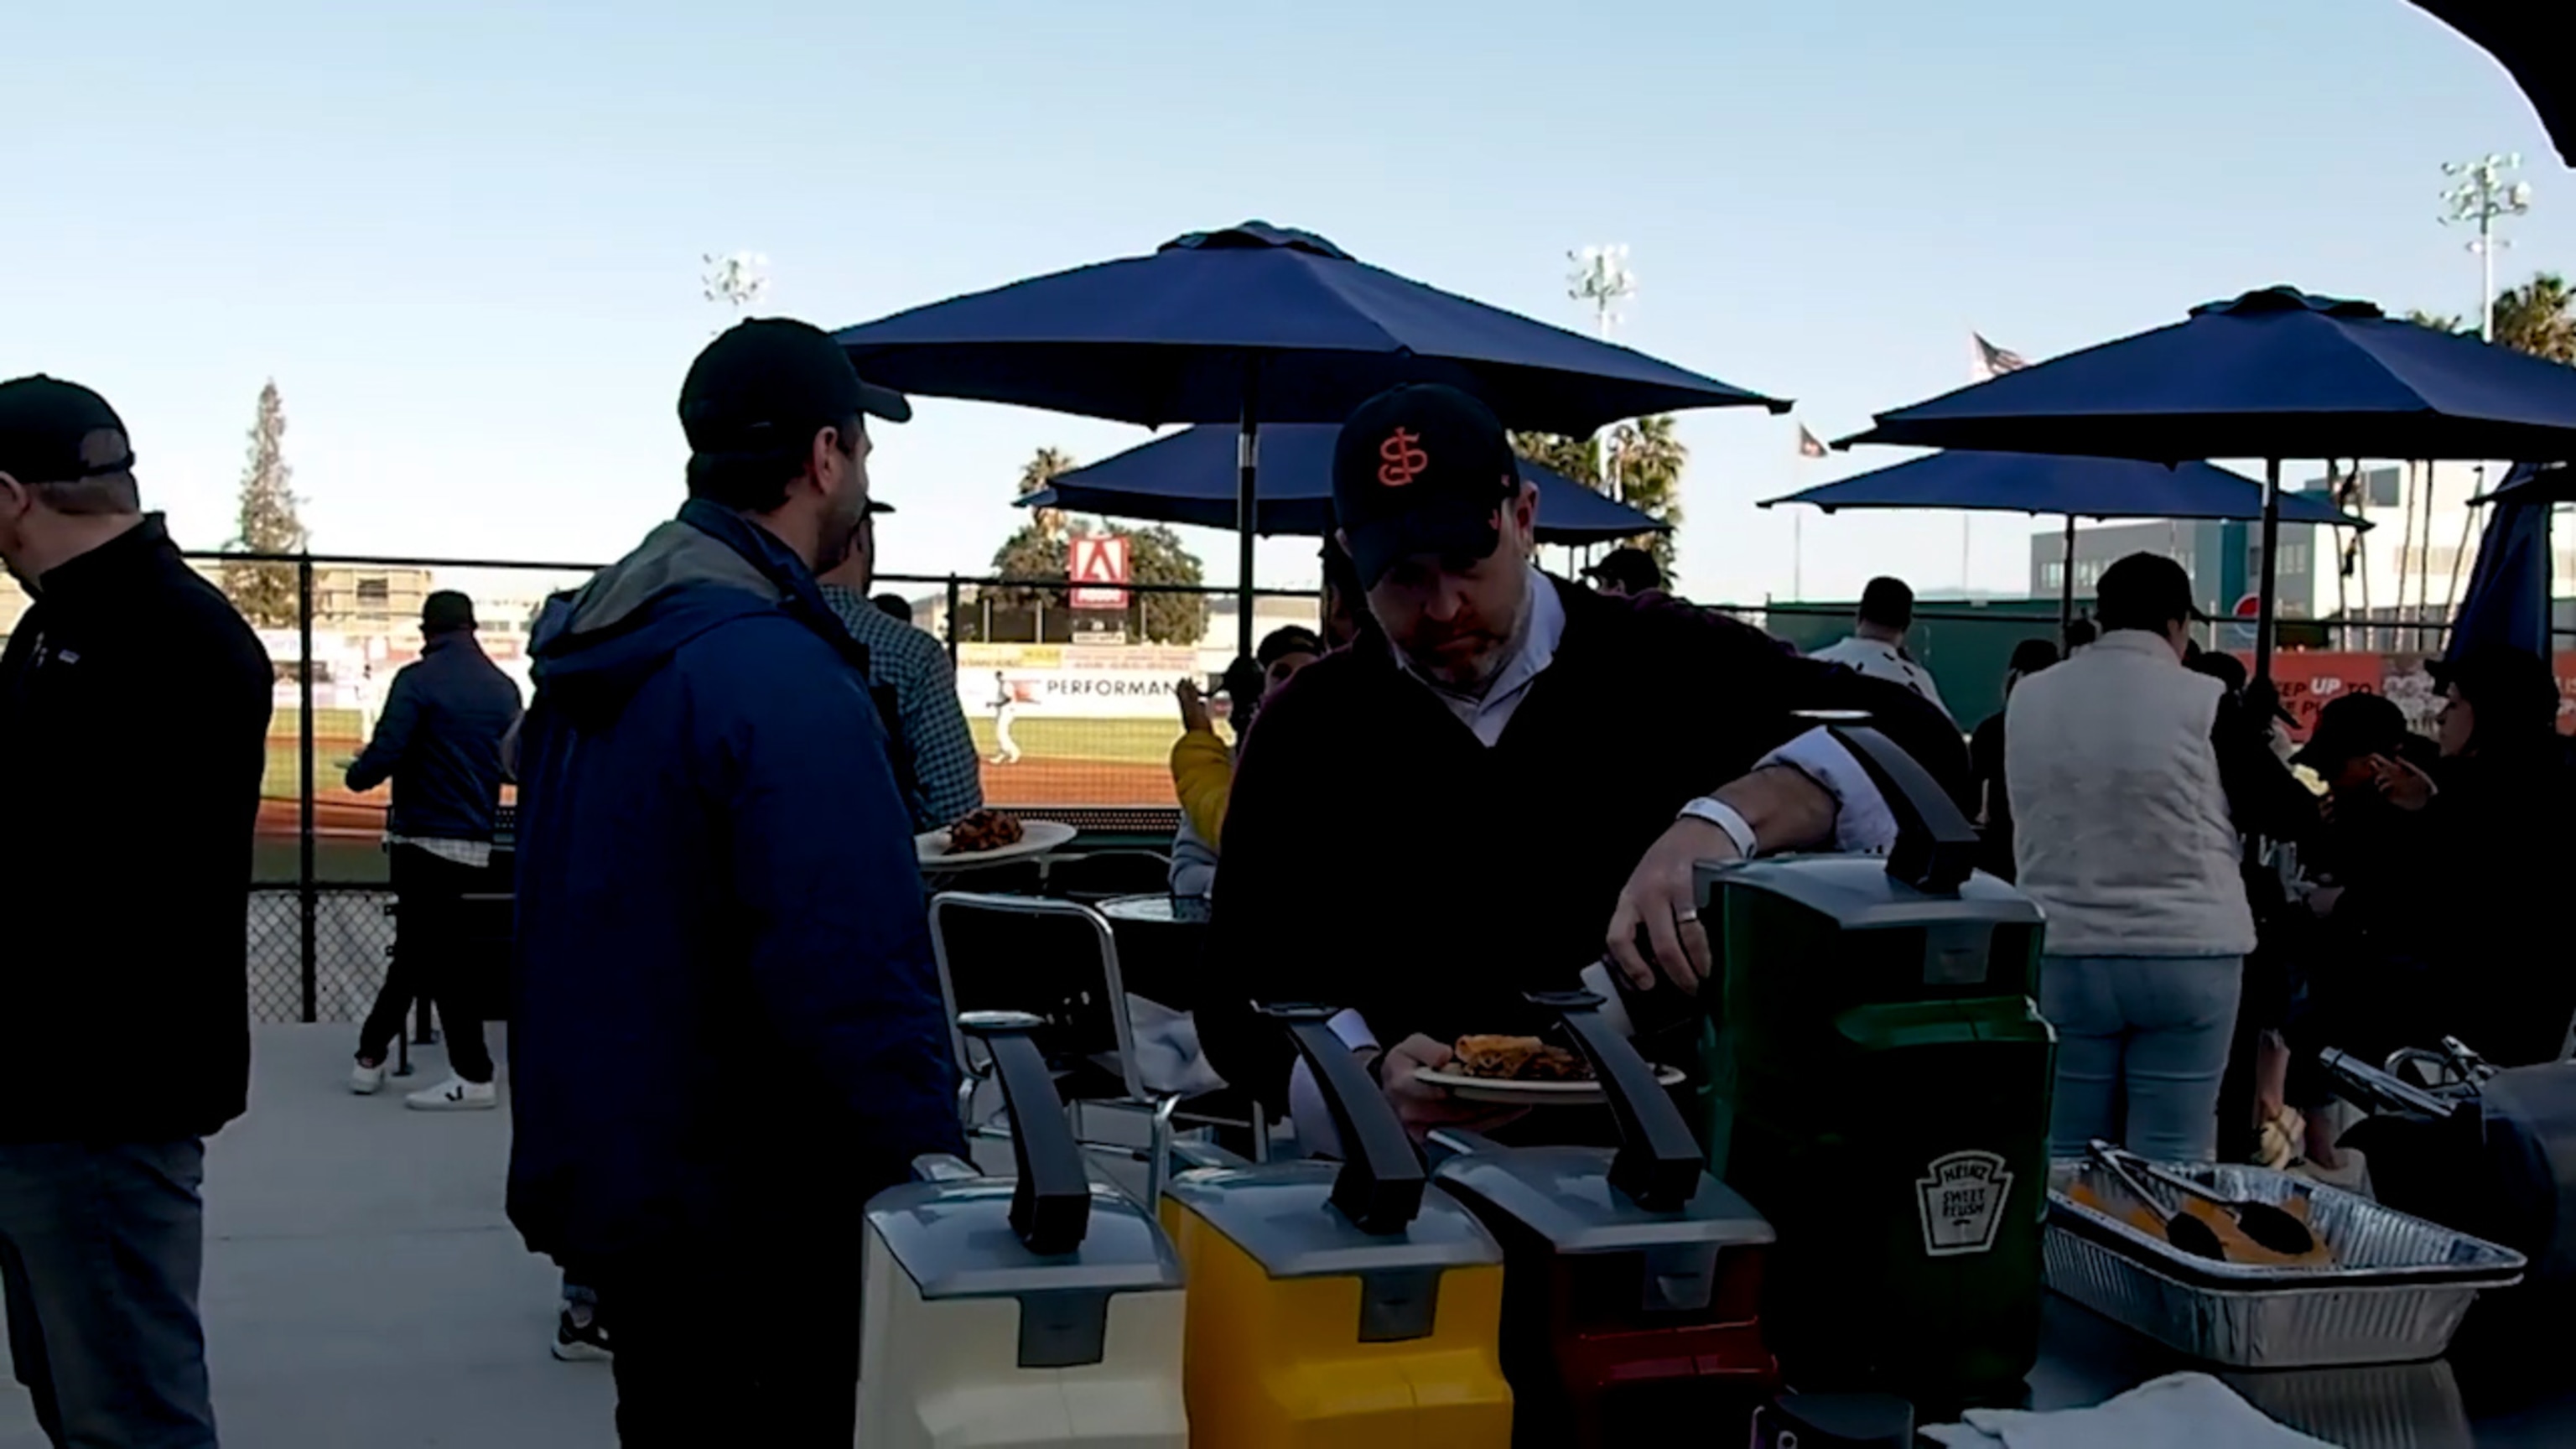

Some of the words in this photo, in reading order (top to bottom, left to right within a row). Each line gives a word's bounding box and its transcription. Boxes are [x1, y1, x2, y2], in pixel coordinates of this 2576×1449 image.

[1047, 680, 1178, 695] PERFORMAN
[2310, 677, 2342, 695] UP
[1944, 1164, 1987, 1182] HEINZ
[1944, 1188, 1985, 1202] SWEET
